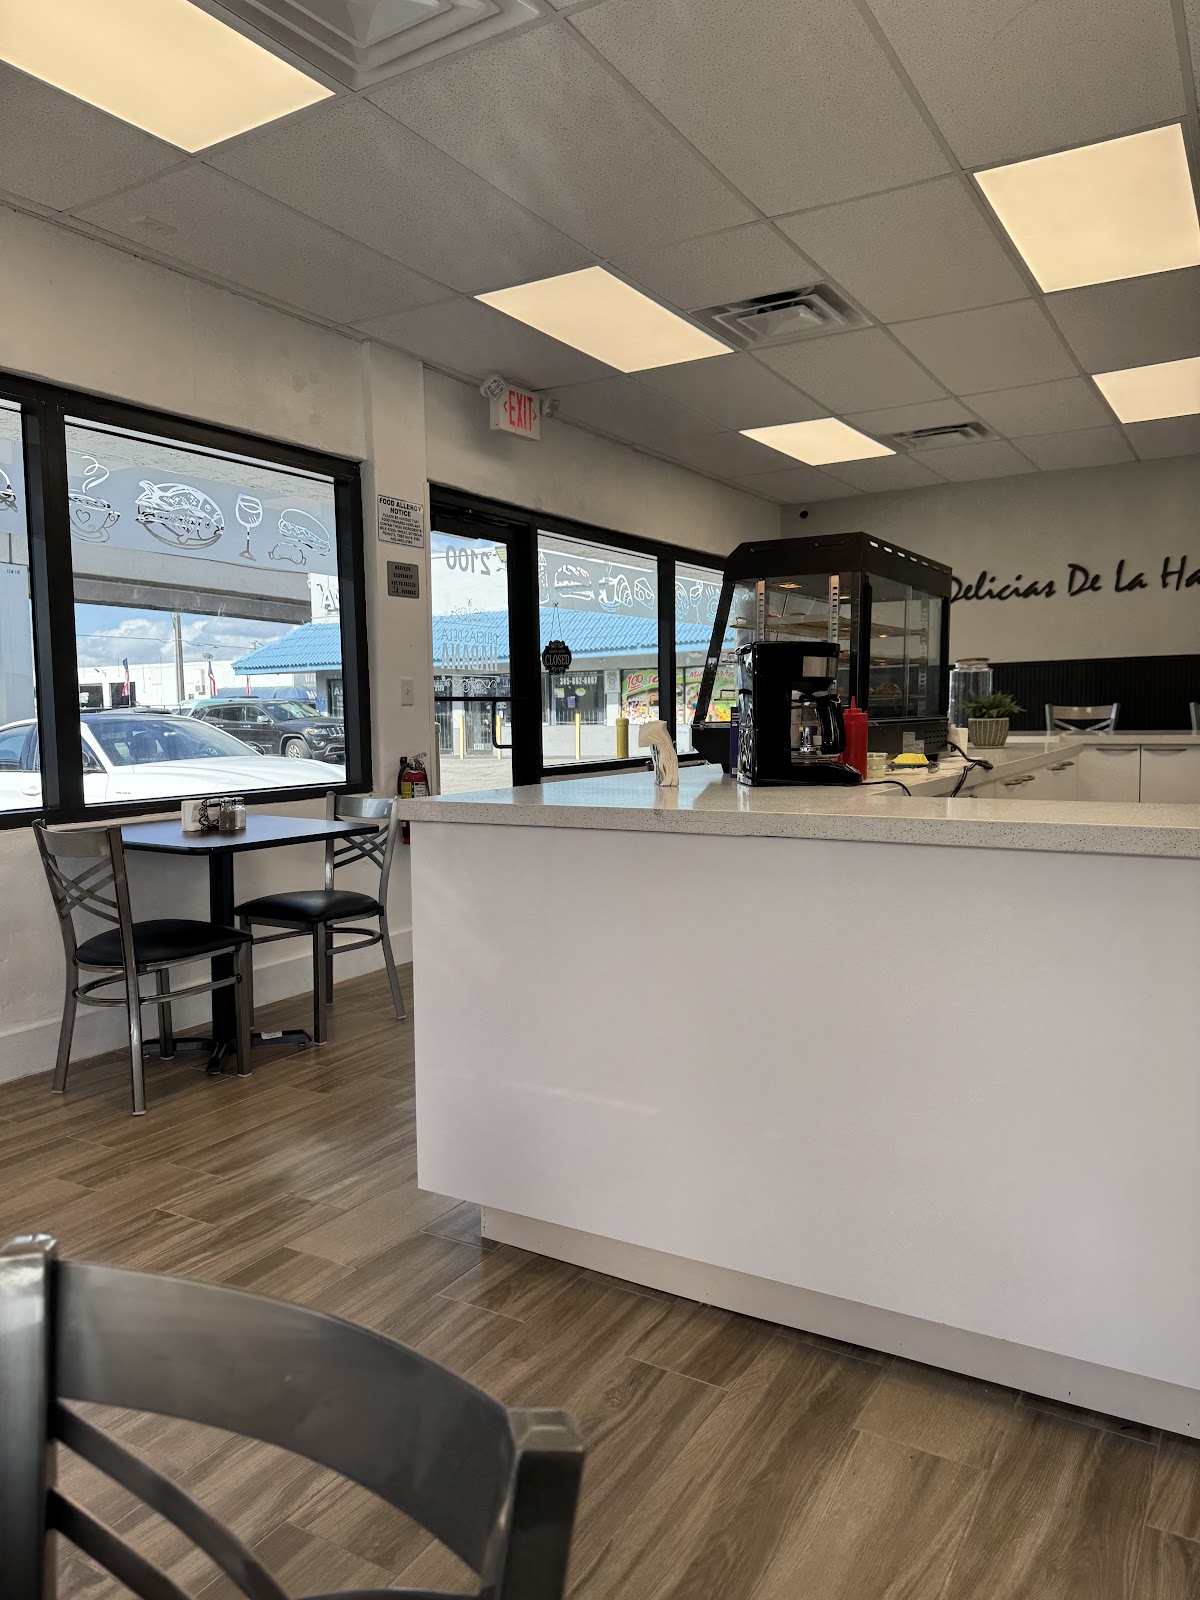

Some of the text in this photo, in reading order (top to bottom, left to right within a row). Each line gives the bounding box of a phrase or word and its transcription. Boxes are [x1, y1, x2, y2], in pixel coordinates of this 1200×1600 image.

[508, 389, 533, 431] EXIT
[379, 497, 422, 513] FOOD ALLERGY
[390, 507, 412, 518] NOTICE
[950, 570, 1056, 604] Delicias
[1068, 562, 1102, 597] De
[1114, 559, 1148, 593] La
[544, 654, 570, 666] CLOSED
